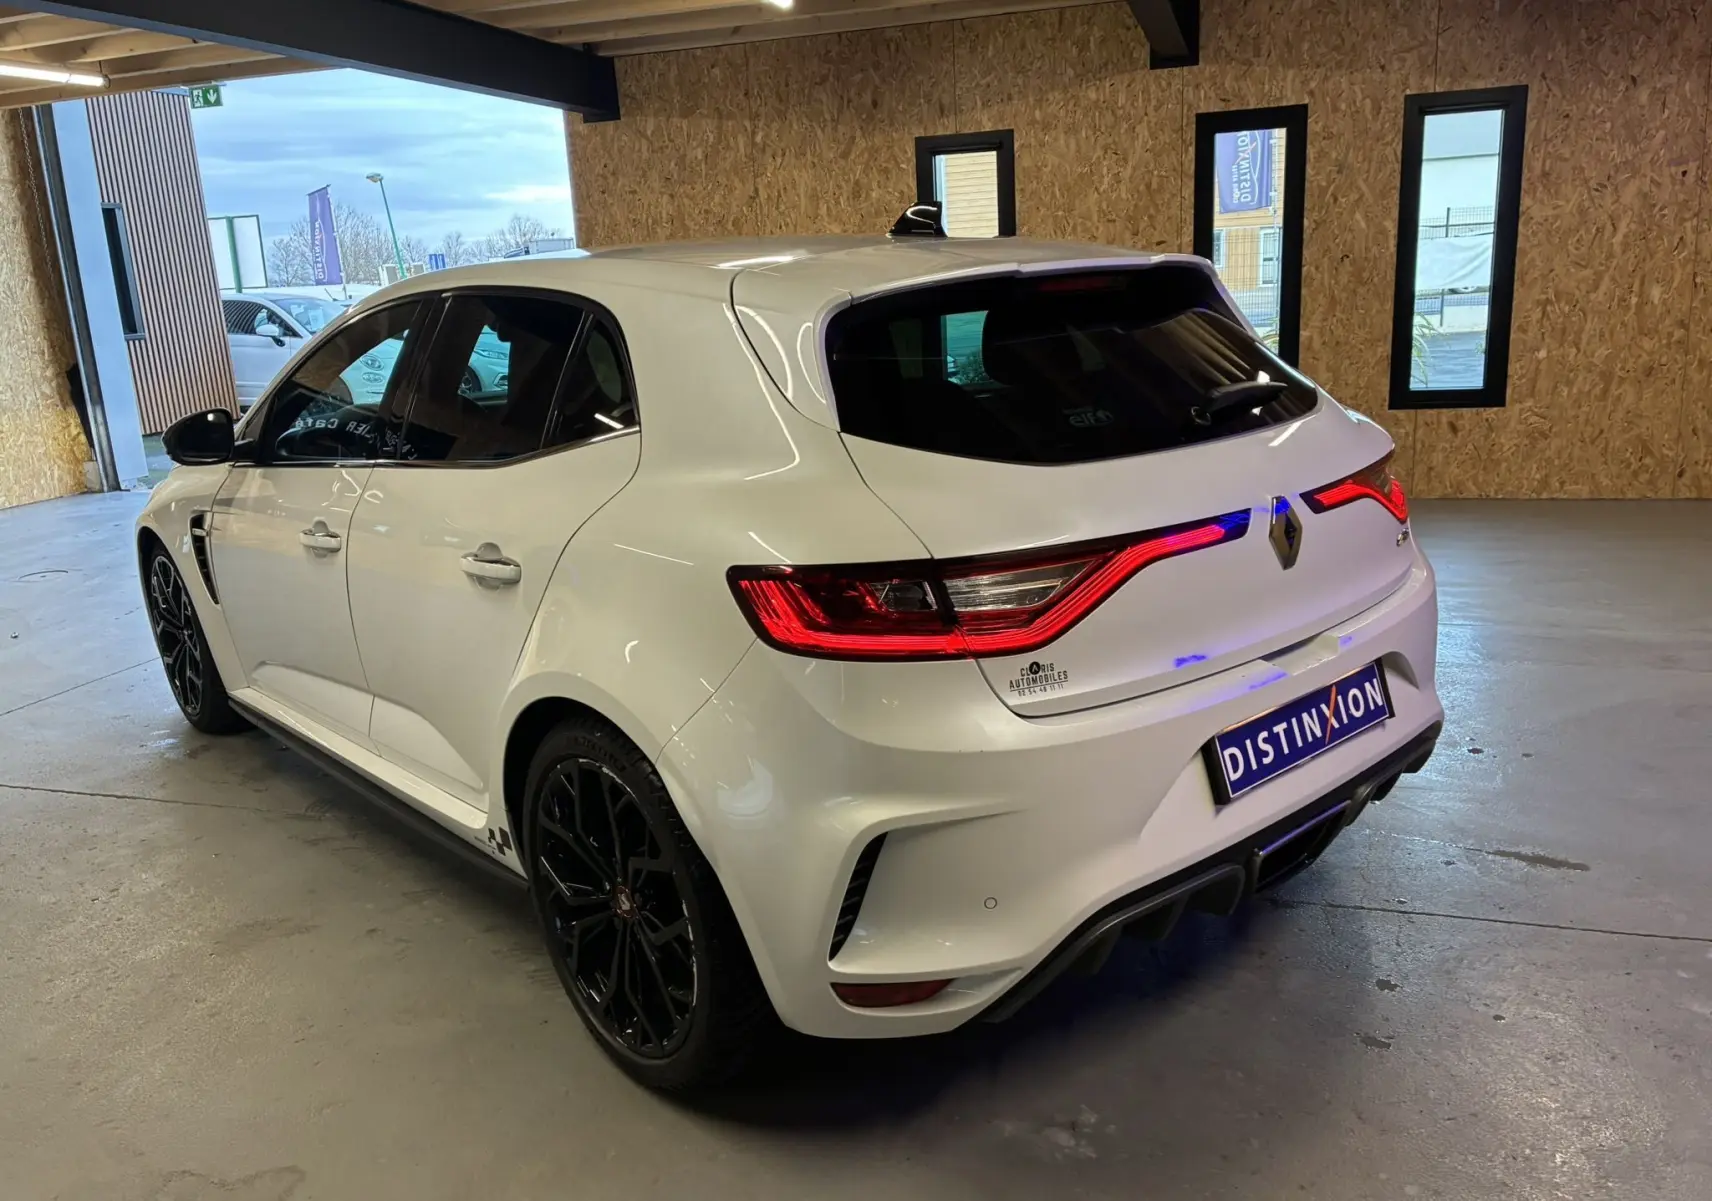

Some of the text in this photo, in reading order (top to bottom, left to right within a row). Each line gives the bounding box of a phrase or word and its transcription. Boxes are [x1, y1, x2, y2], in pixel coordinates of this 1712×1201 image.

[1020, 661, 1055, 677] CLARIS
[1009, 670, 1069, 690] AUTOMOBILES
[1222, 677, 1384, 783] DISTINXION
